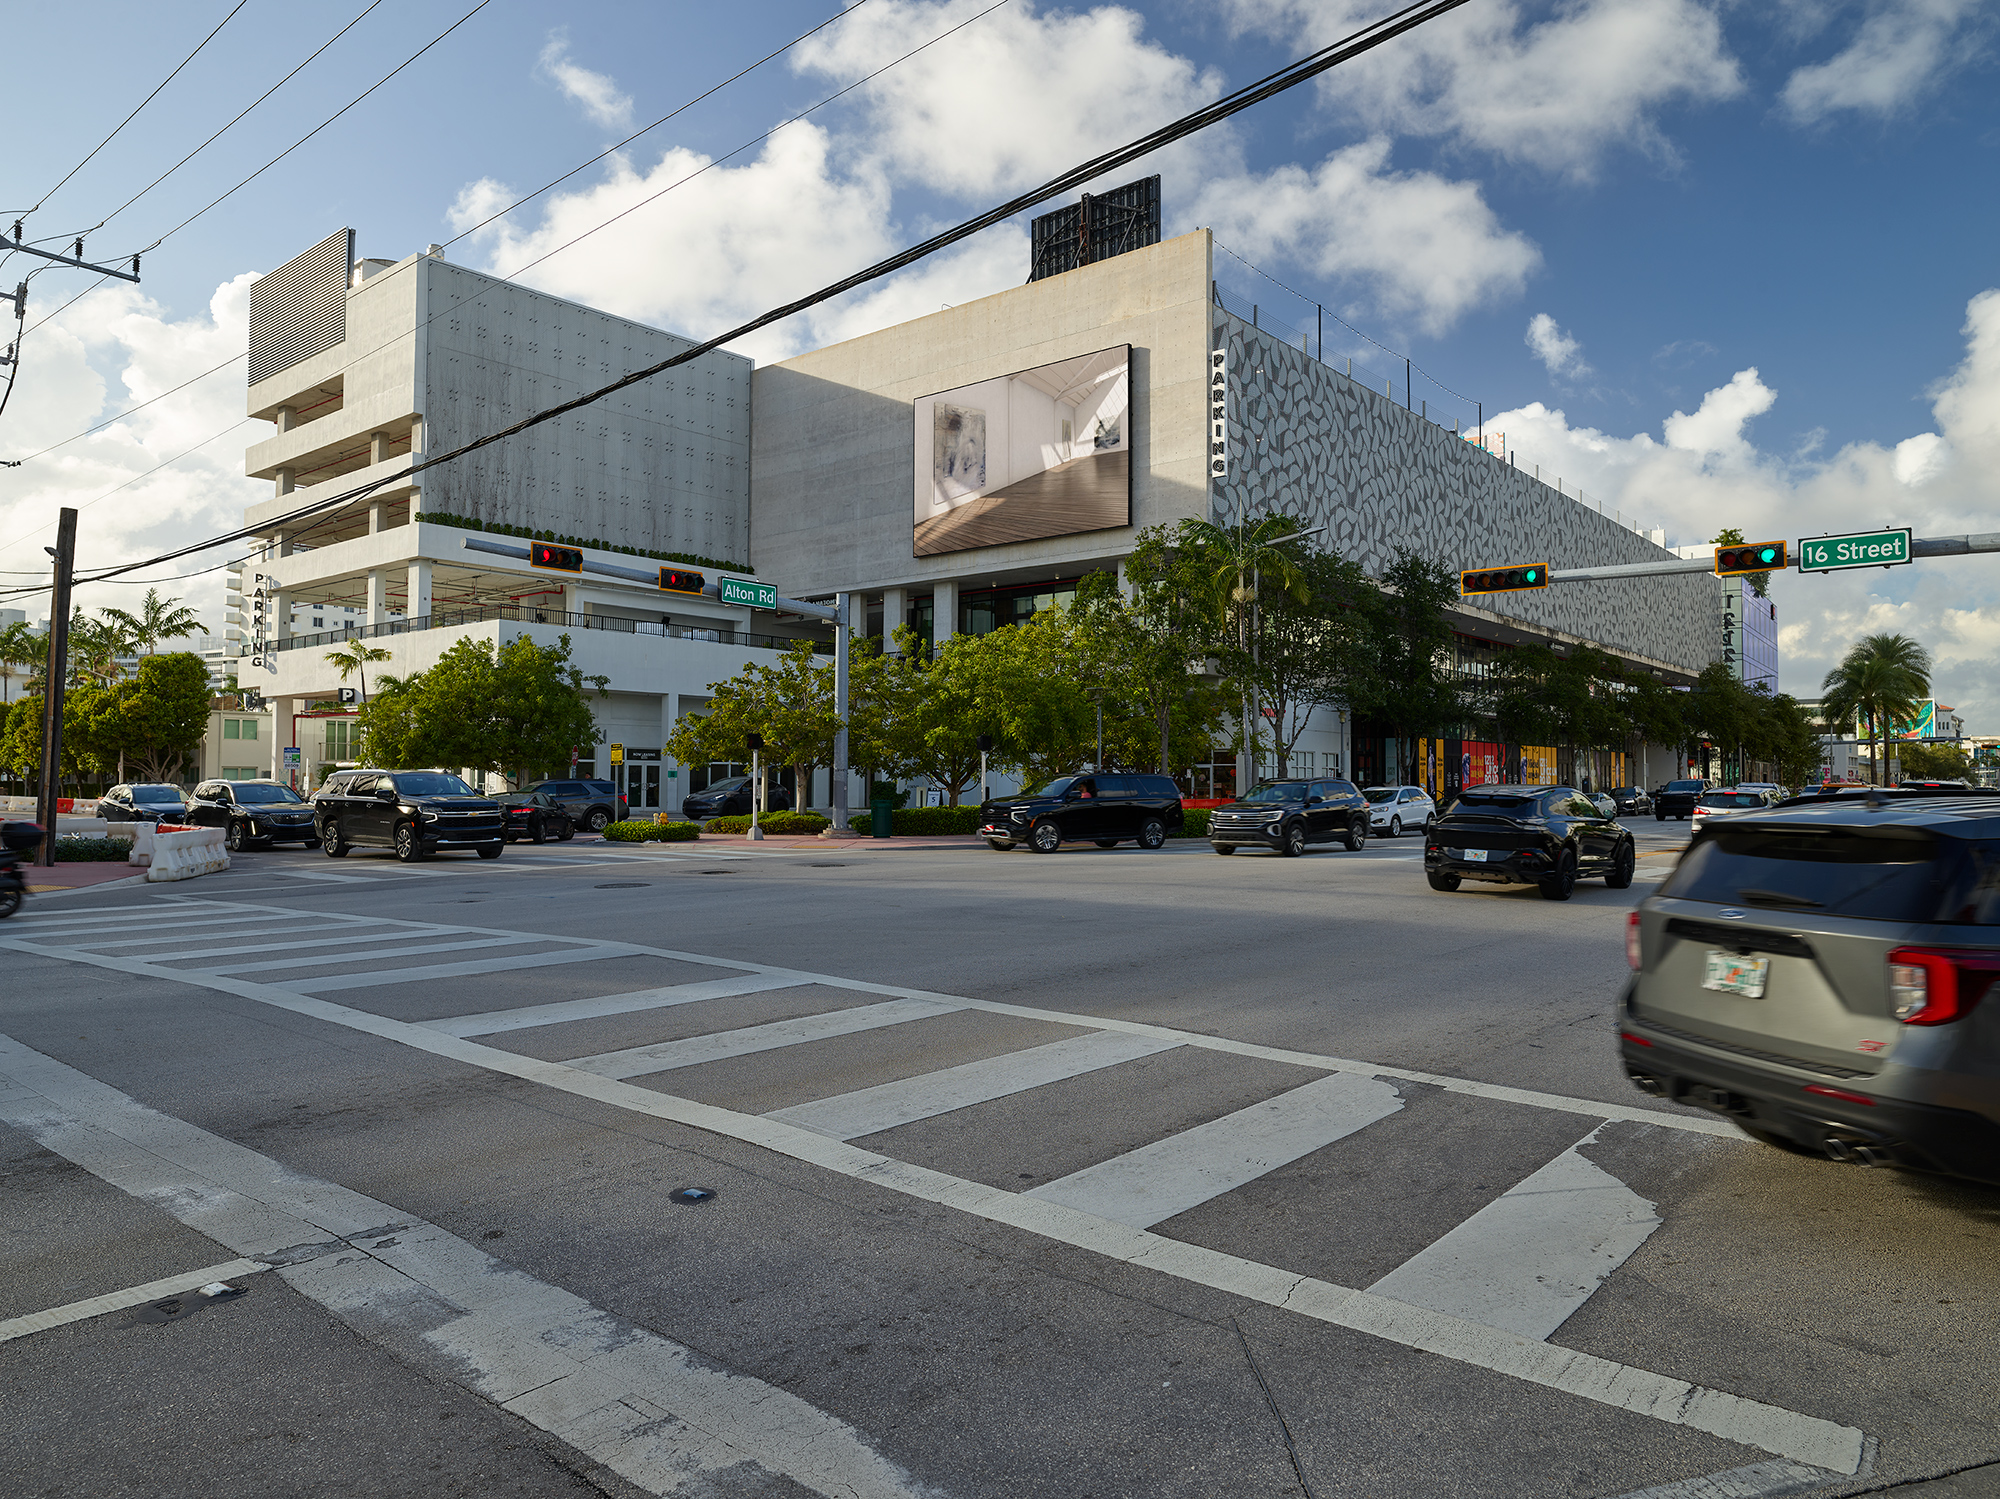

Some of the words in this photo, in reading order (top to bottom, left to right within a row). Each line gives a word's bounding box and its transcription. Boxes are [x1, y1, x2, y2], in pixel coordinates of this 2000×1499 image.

[1211, 354, 1225, 473] PARKING
[1807, 545, 1829, 564] 16
[1837, 538, 1902, 561] Street
[725, 584, 755, 601] Alton
[759, 589, 774, 604] Rd
[252, 573, 264, 667] PARKING
[343, 690, 353, 700] P
